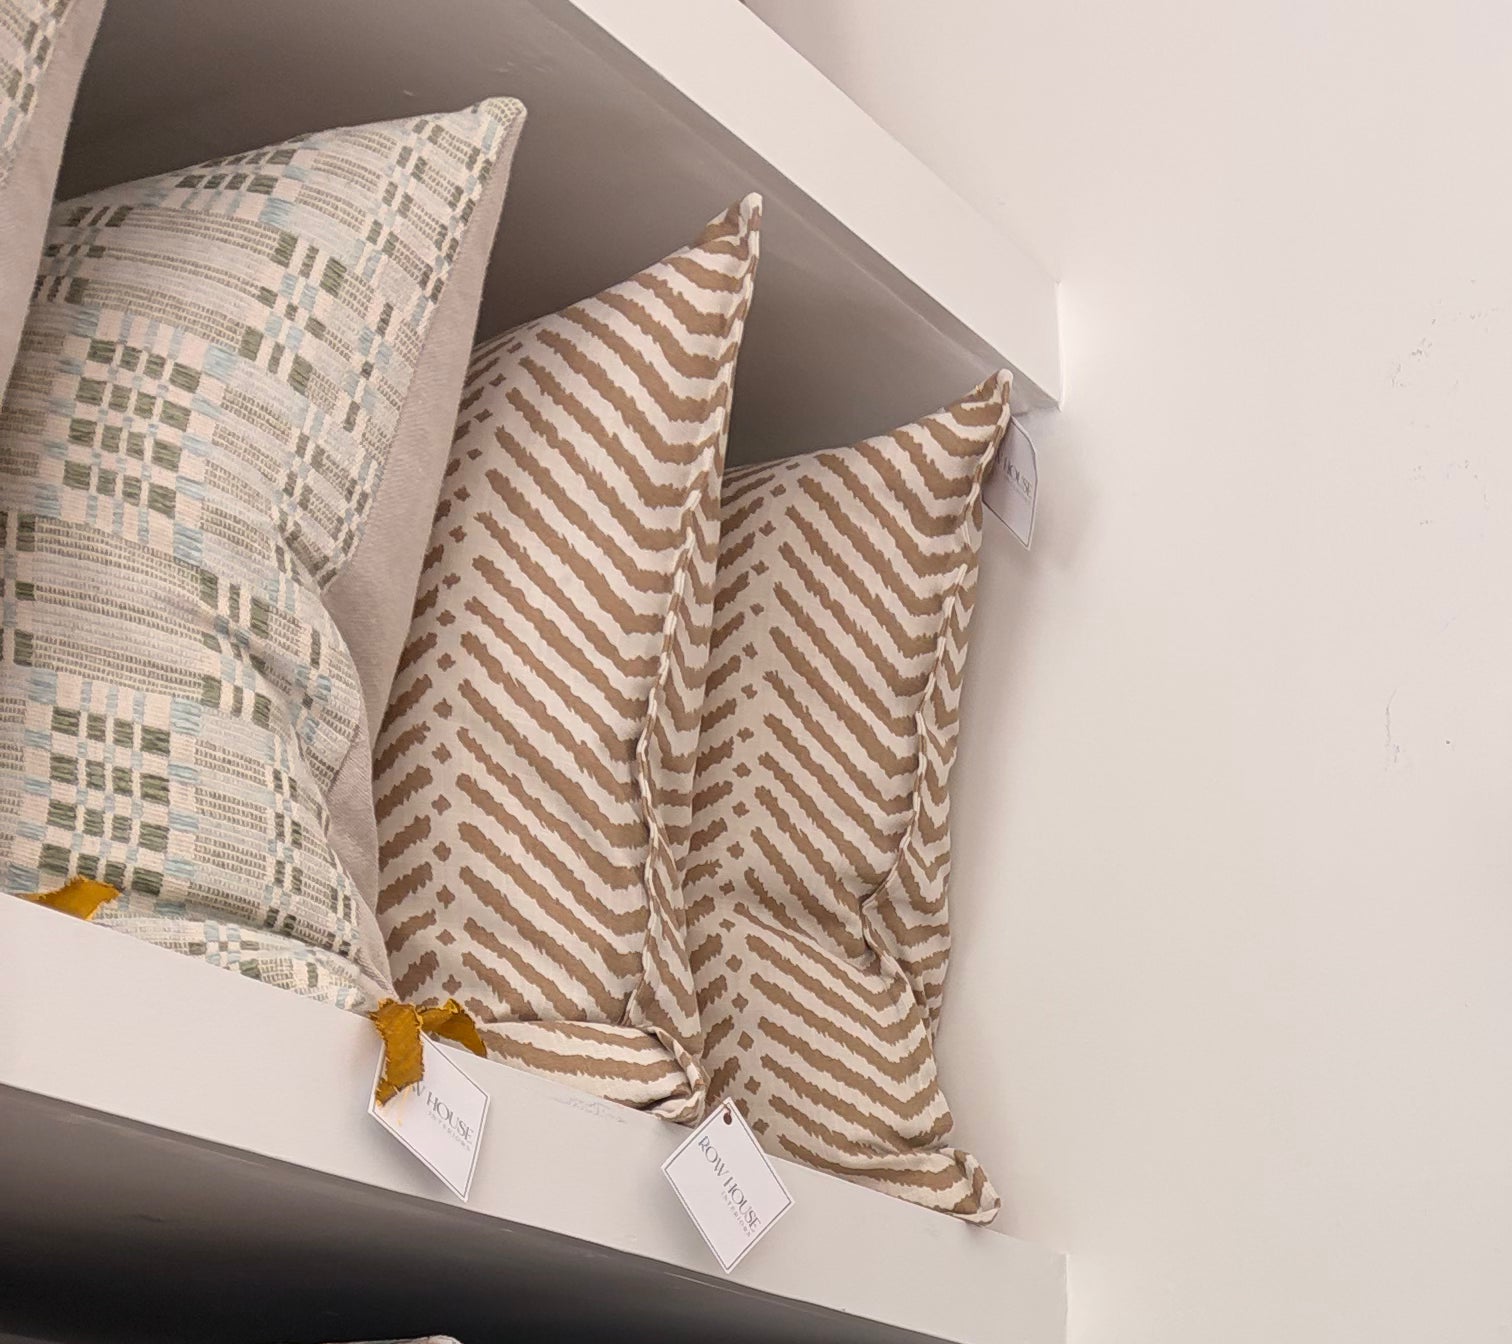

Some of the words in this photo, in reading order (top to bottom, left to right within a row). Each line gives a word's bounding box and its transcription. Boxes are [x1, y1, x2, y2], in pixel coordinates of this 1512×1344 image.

[426, 1091, 474, 1141] HOUSE
[698, 1135, 729, 1177] ROW
[723, 1176, 762, 1233] HOUSE
